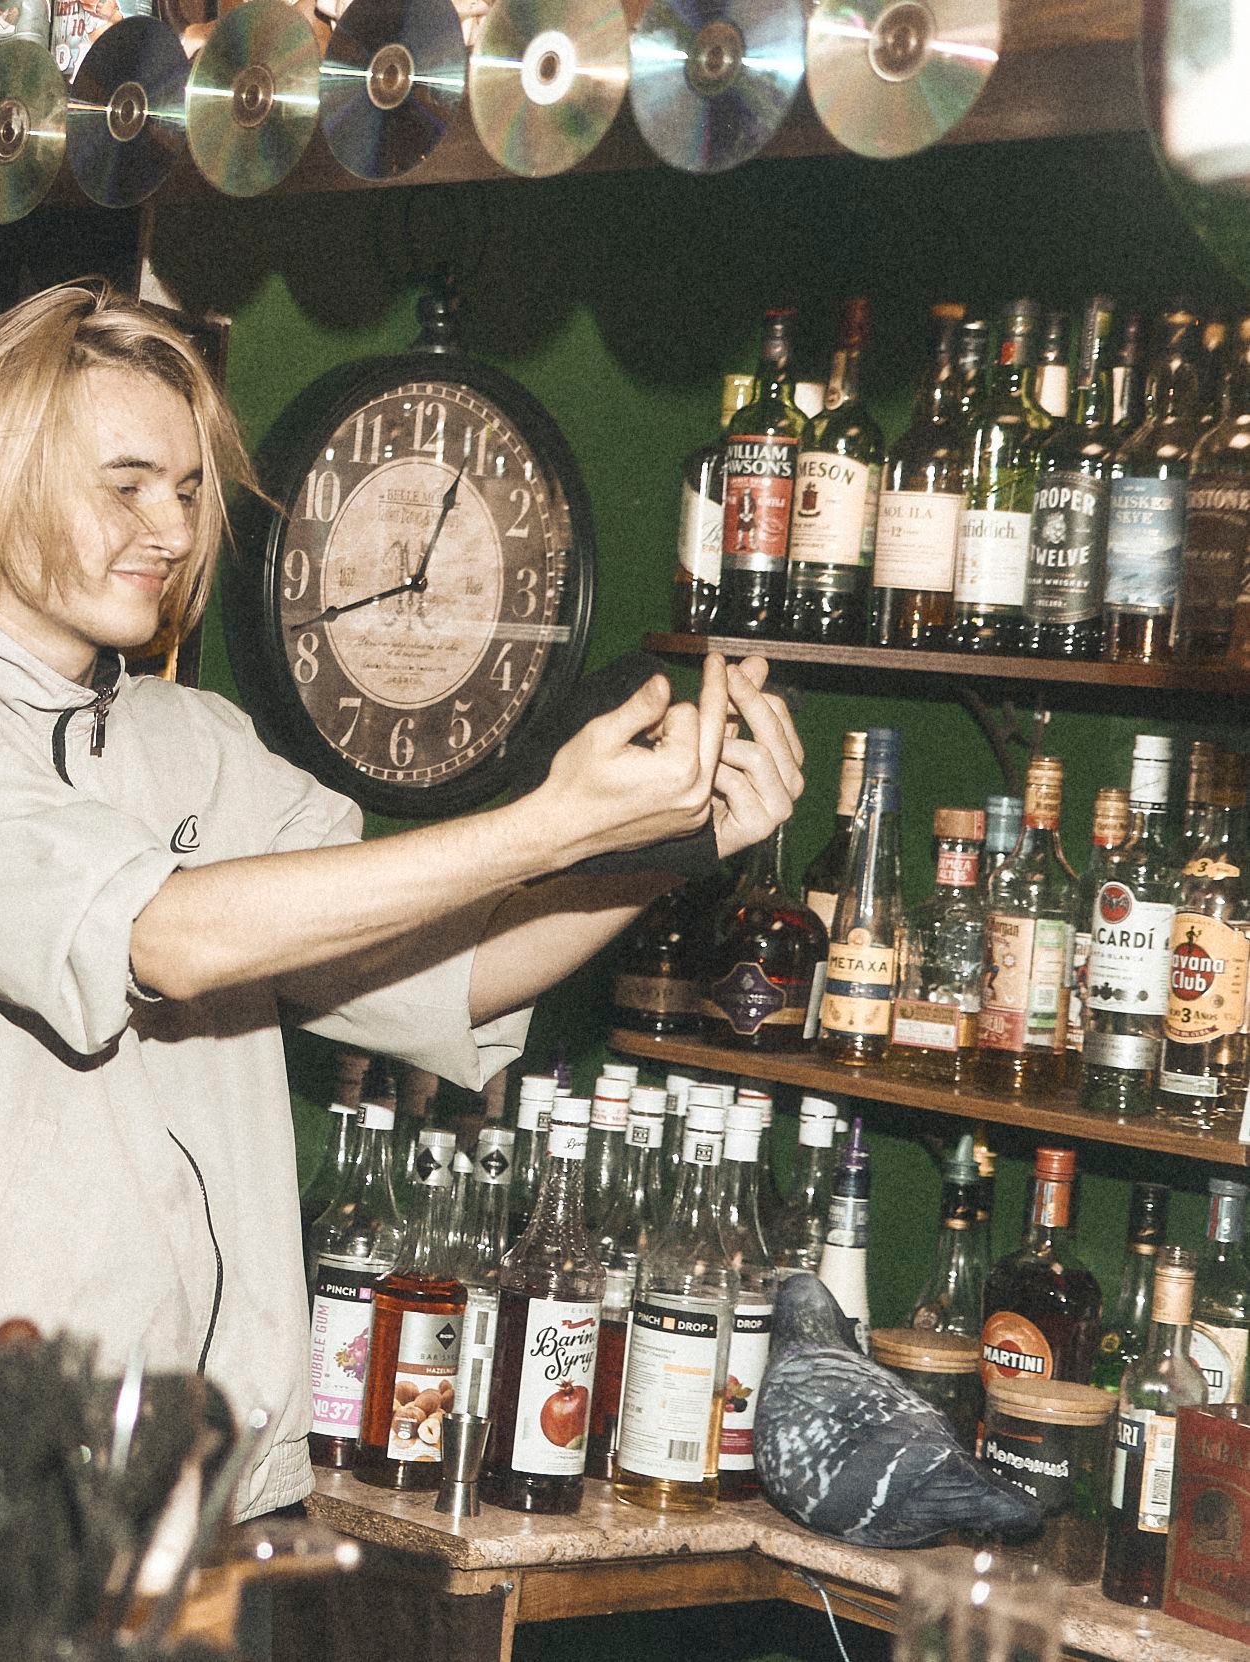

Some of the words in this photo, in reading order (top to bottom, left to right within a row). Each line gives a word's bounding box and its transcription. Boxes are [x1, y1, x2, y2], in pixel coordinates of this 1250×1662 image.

[349, 414, 384, 465] 11
[411, 400, 446, 456] 12
[473, 428, 490, 477] 1
[302, 469, 342, 524] 10
[505, 489, 532, 539] 2
[1033, 487, 1097, 517] PROPER
[284, 549, 311, 602] 9
[1030, 544, 1091, 568] TWELVE
[511, 569, 539, 619] 3
[294, 632, 321, 684] 8
[490, 643, 513, 693] 4
[337, 696, 363, 748] 7
[389, 717, 416, 768] 6
[449, 700, 474, 750] 5
[830, 956, 889, 973] METAXA
[1171, 970, 1207, 992] Club
[1181, 1007, 1192, 1023] 3
[326, 1284, 357, 1297] PINCH
[311, 1336, 326, 1388] BUBBLE
[319, 1304, 330, 1333] GUM
[637, 1311, 661, 1326] PINCH
[677, 1320, 708, 1333] DROP
[736, 1319, 762, 1329] DROP
[983, 1345, 1044, 1373] MARTINI
